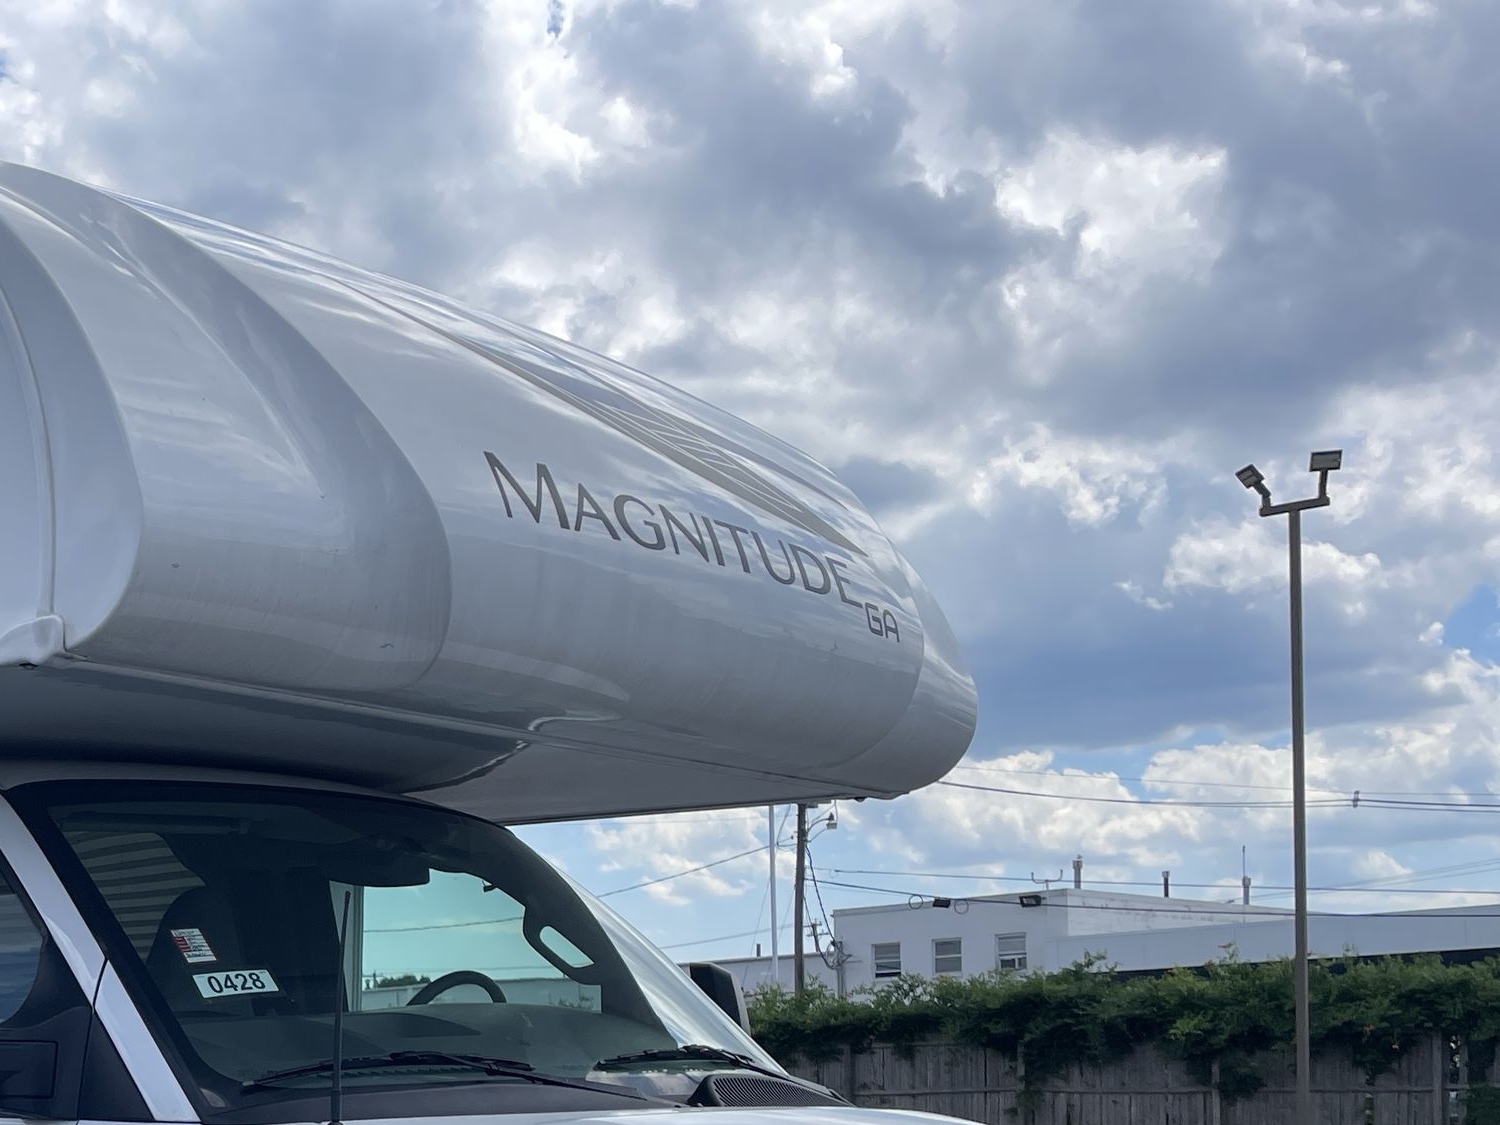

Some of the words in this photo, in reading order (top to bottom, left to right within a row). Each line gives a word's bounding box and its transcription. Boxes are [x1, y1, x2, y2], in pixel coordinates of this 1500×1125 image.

[483, 451, 863, 608] MAGNITUDE
[865, 602, 900, 643] GA
[207, 972, 266, 994] 0428
